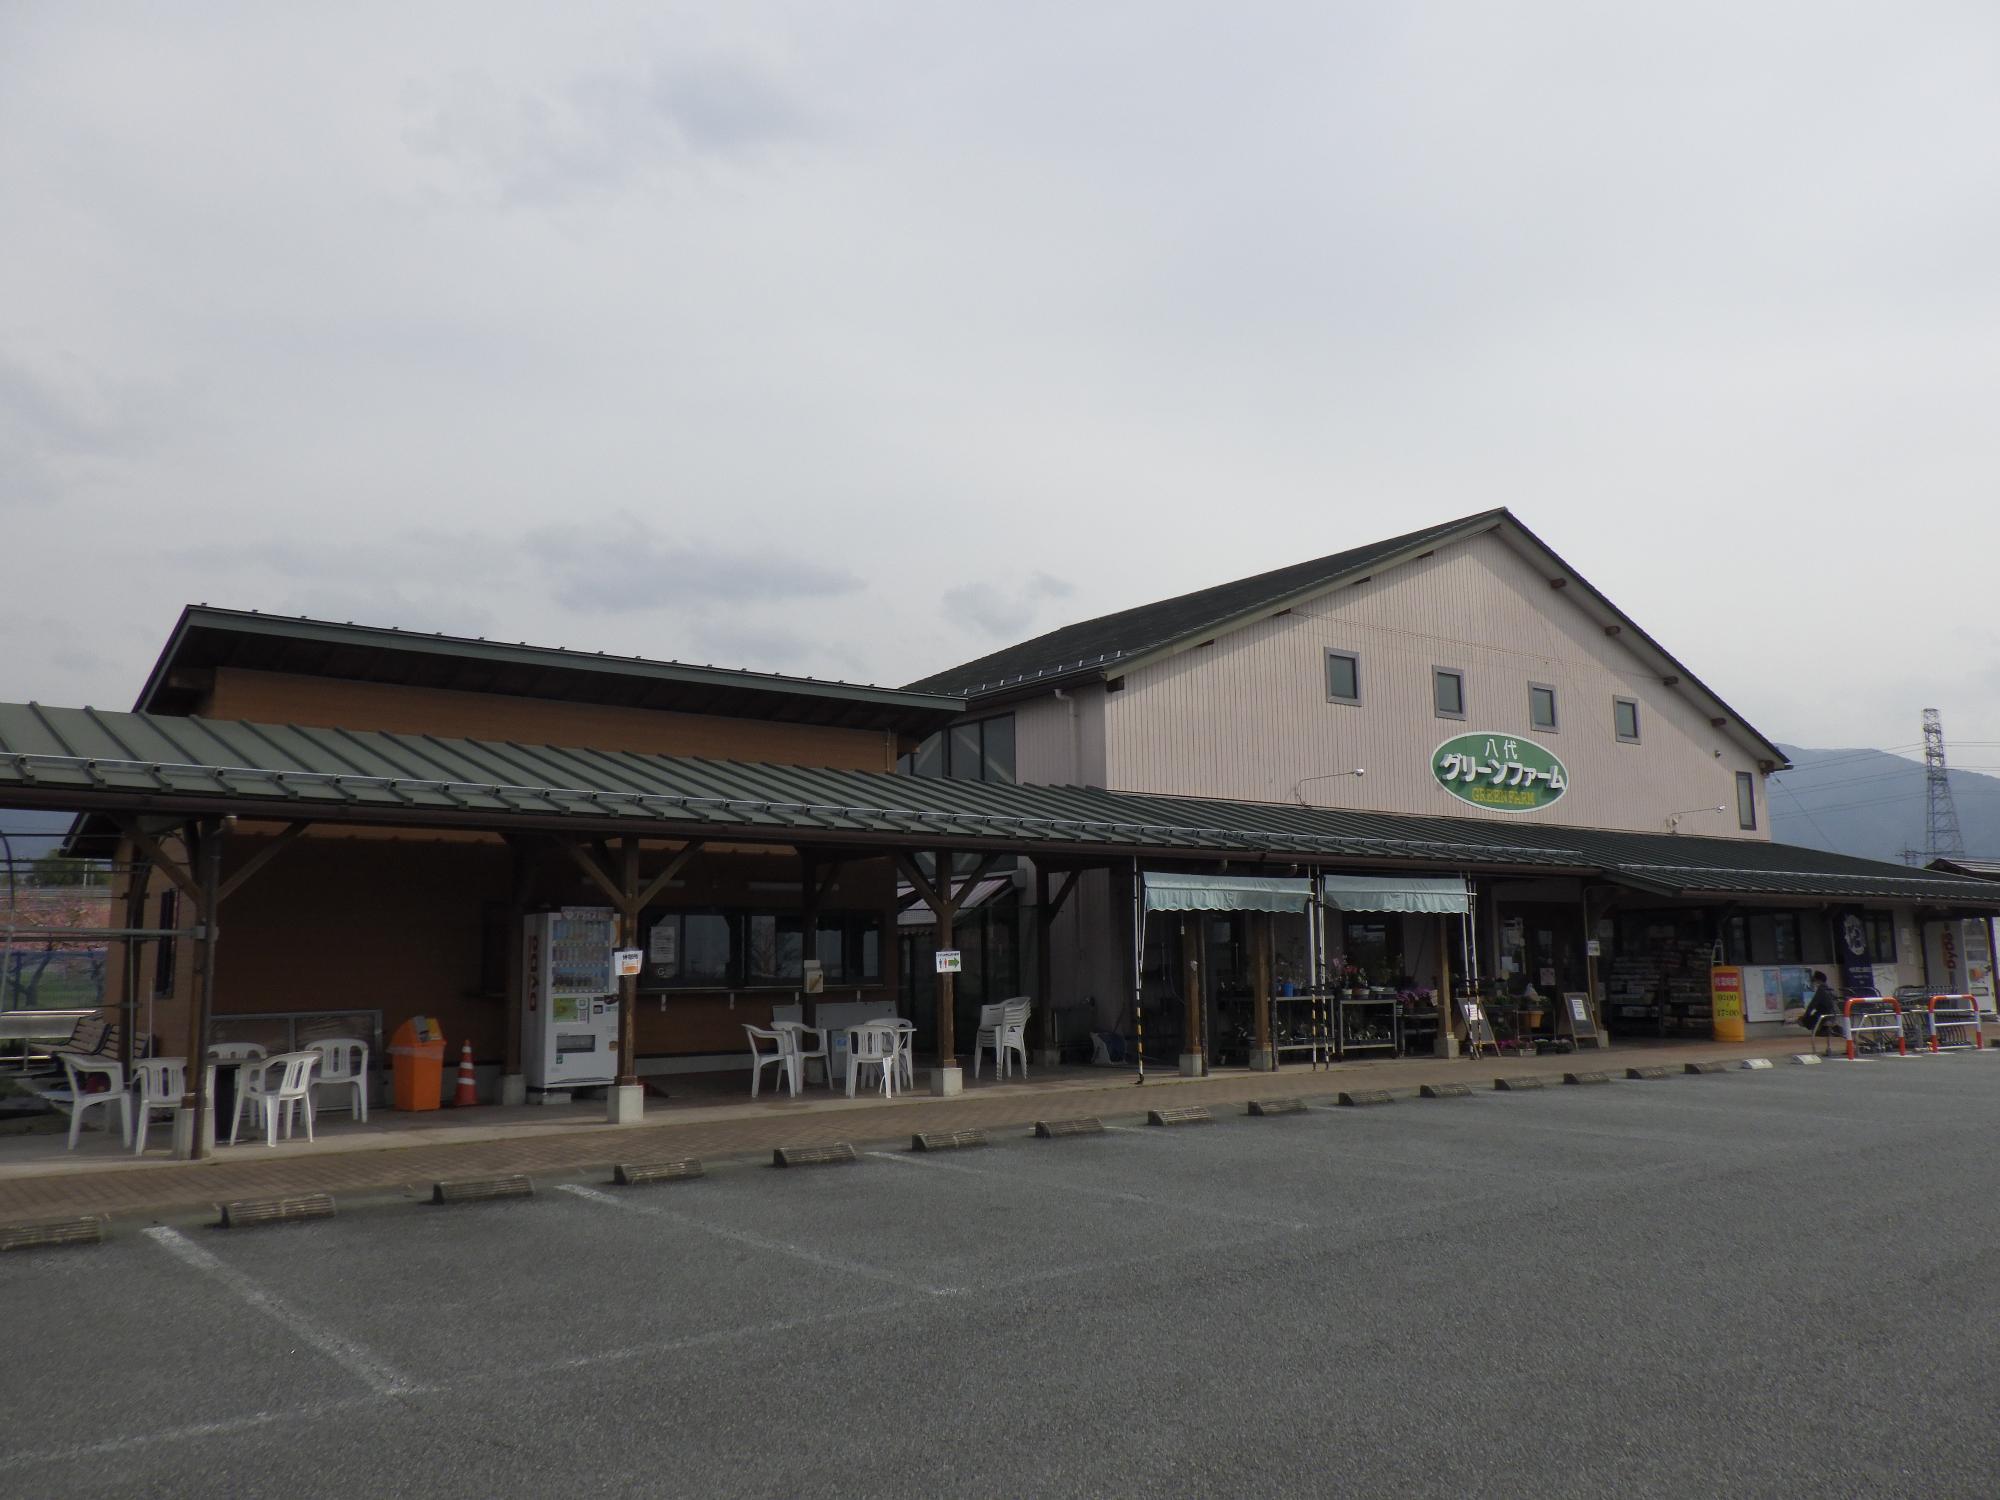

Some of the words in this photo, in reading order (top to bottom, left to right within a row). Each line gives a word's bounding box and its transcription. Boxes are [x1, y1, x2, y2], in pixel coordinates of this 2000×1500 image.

[1485, 738, 1518, 760] 八代
[1440, 753, 1566, 790] グリーンファーム
[1471, 787, 1508, 803] GREEN
